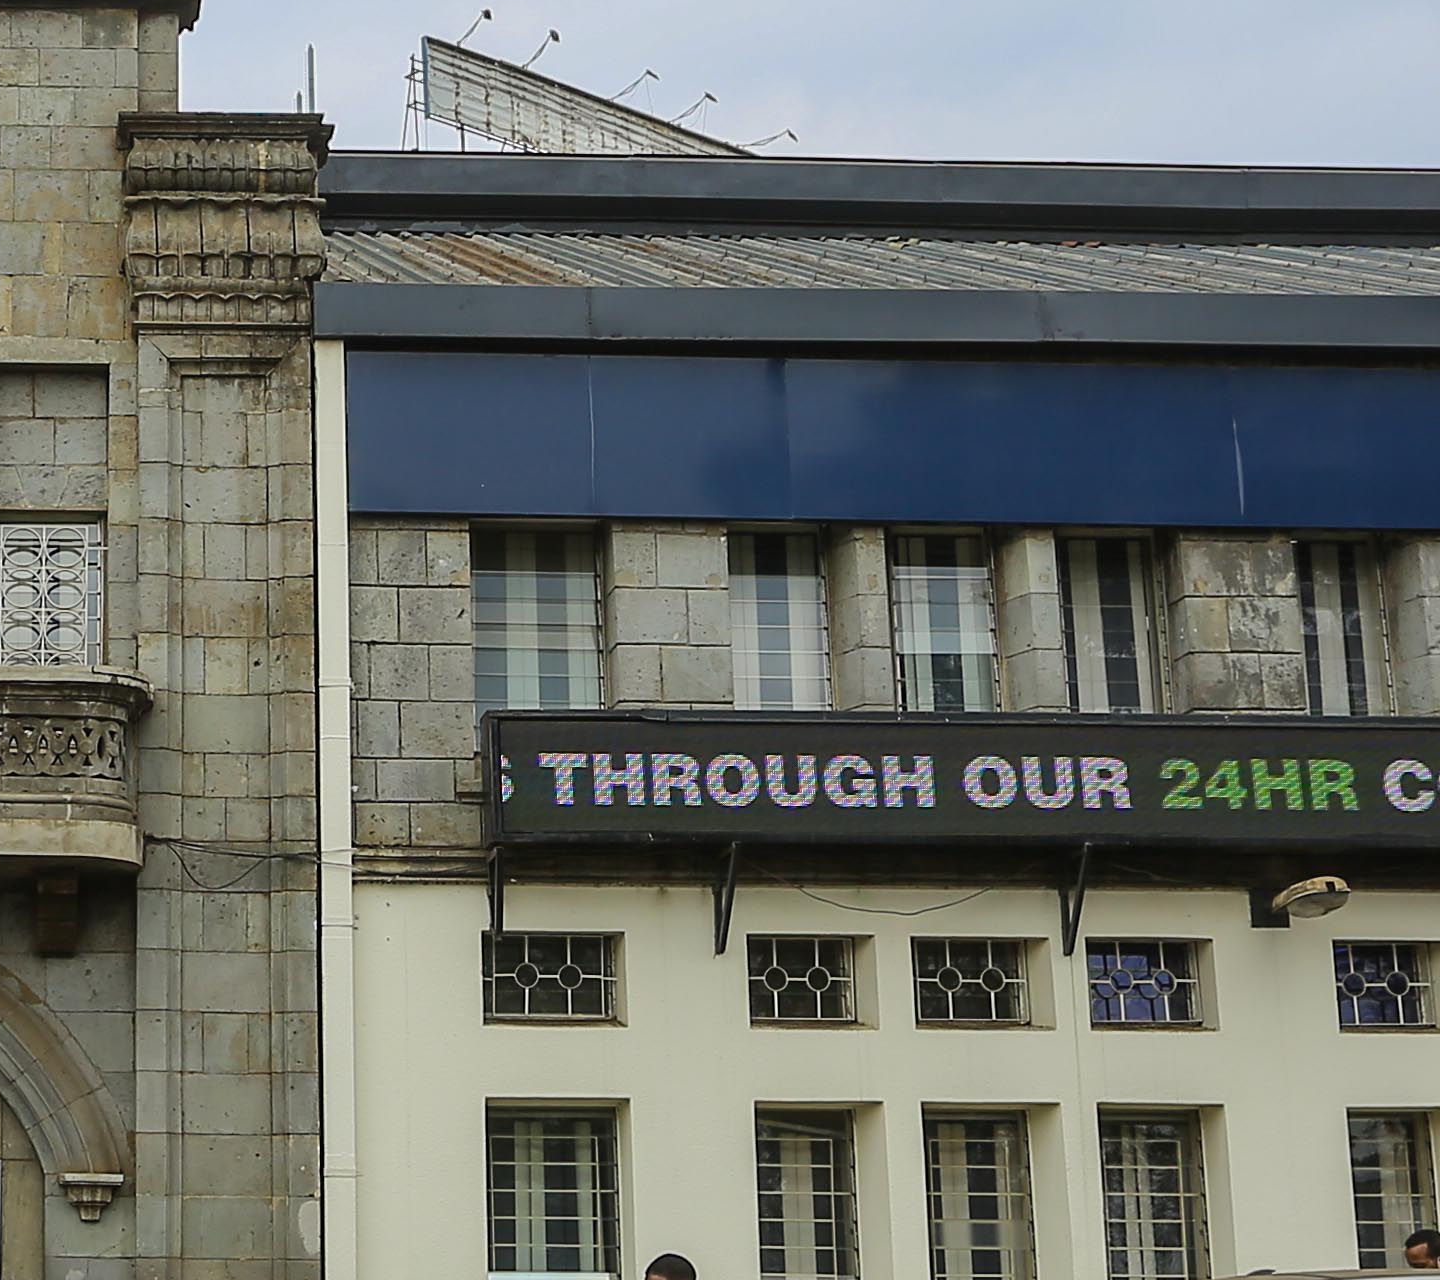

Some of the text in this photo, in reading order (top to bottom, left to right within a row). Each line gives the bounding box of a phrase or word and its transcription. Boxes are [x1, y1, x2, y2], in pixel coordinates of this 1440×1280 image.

[537, 752, 937, 808] THROUGH
[961, 756, 1134, 810] OUR
[1159, 758, 1361, 812] 24HR
